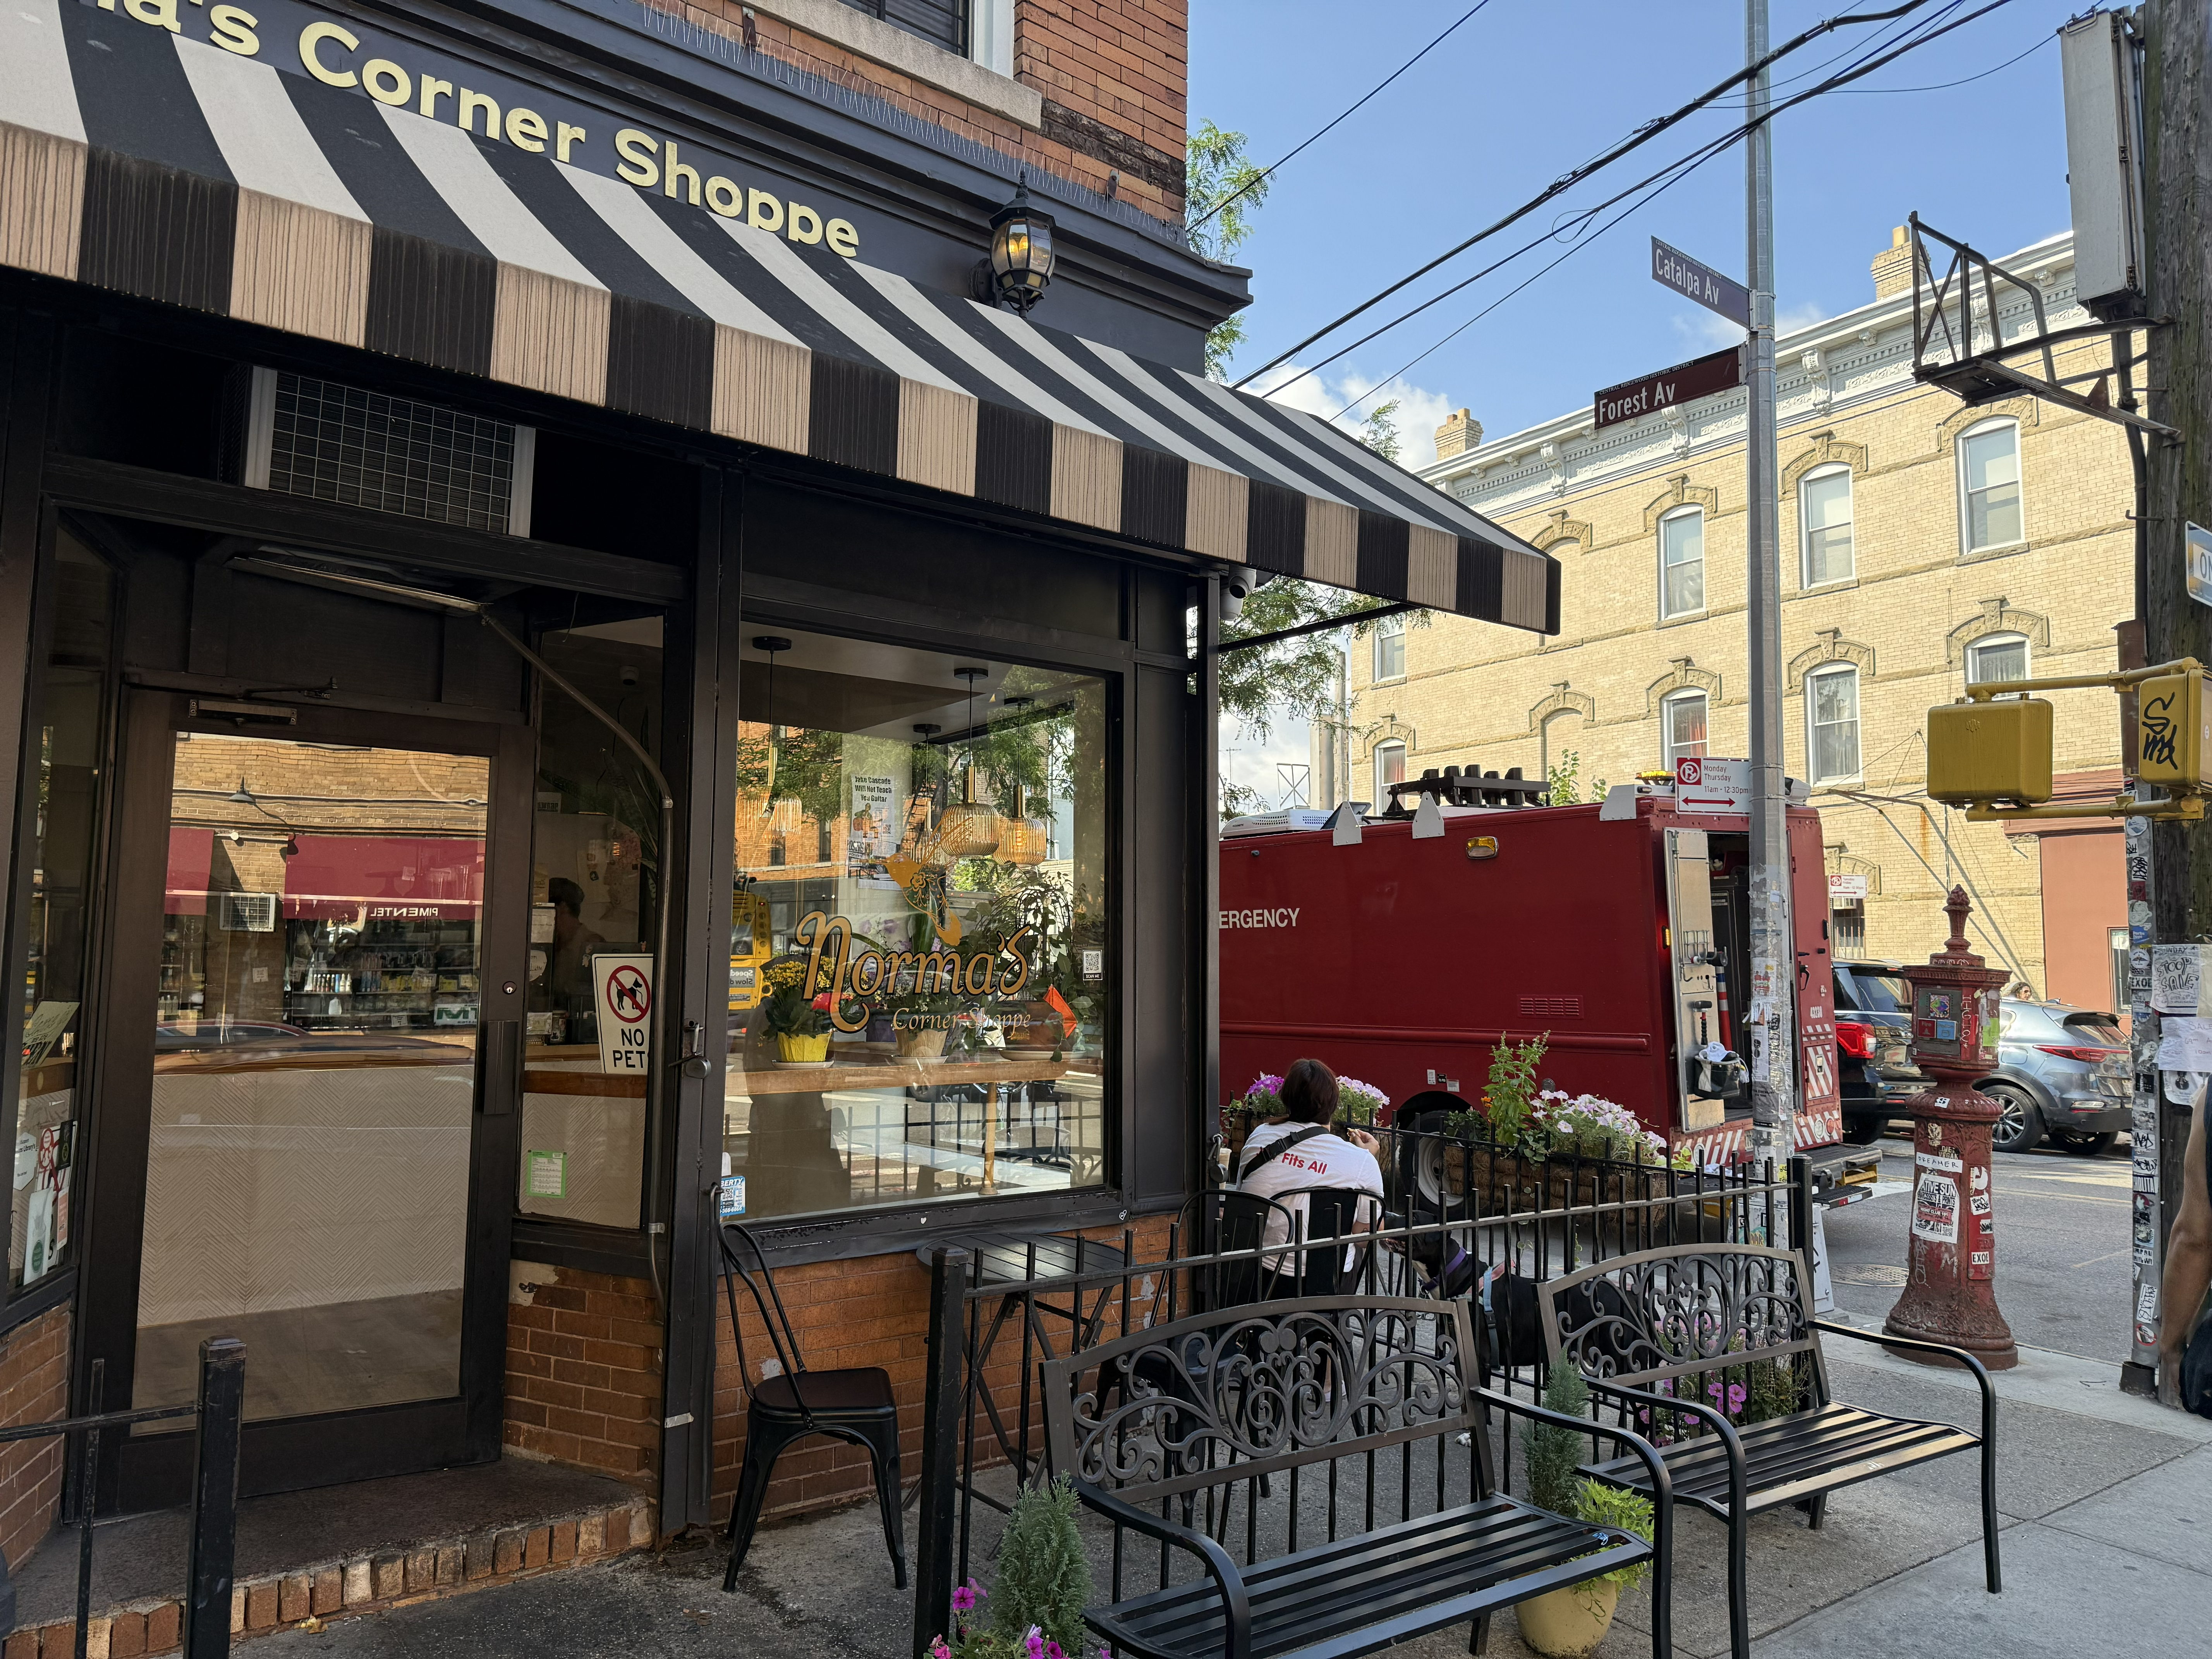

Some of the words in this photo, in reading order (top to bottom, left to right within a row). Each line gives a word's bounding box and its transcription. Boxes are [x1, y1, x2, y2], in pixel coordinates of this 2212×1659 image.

[299, 21, 585, 162] Corner
[615, 128, 860, 258] Shoppe
[1656, 239, 1671, 252] CENTRAL
[1707, 267, 1722, 279] DISTRICT
[1656, 249, 1700, 295] Catalpa
[1705, 276, 1719, 305] Av
[1599, 385, 1620, 395] CENTRAL
[1620, 375, 1649, 388] RIDGEWOOD
[1649, 368, 1671, 379] HISTORIC
[1672, 361, 1694, 372] DISTRICT
[1599, 386, 1647, 423] Forest
[1654, 382, 1675, 407] Av
[1704, 765, 1727, 774] Monday
[1704, 774, 1731, 782] Thursday
[1724, 787, 1748, 795] 12:30pm
[795, 909, 1031, 1034] Norma's
[2157, 957, 2192, 977] STOOP
[2161, 973, 2200, 993] SALE
[893, 1008, 959, 1030] Corner
[621, 1028, 644, 1046] NO
[613, 1050, 649, 1068] PET
[1281, 1152, 1305, 1168] Fits
[1307, 1161, 1328, 1175] All
[1938, 1152, 1958, 1160] VEGAN
[1940, 1183, 1956, 1197] SUN
[1942, 1196, 1956, 1206] PRINTS
